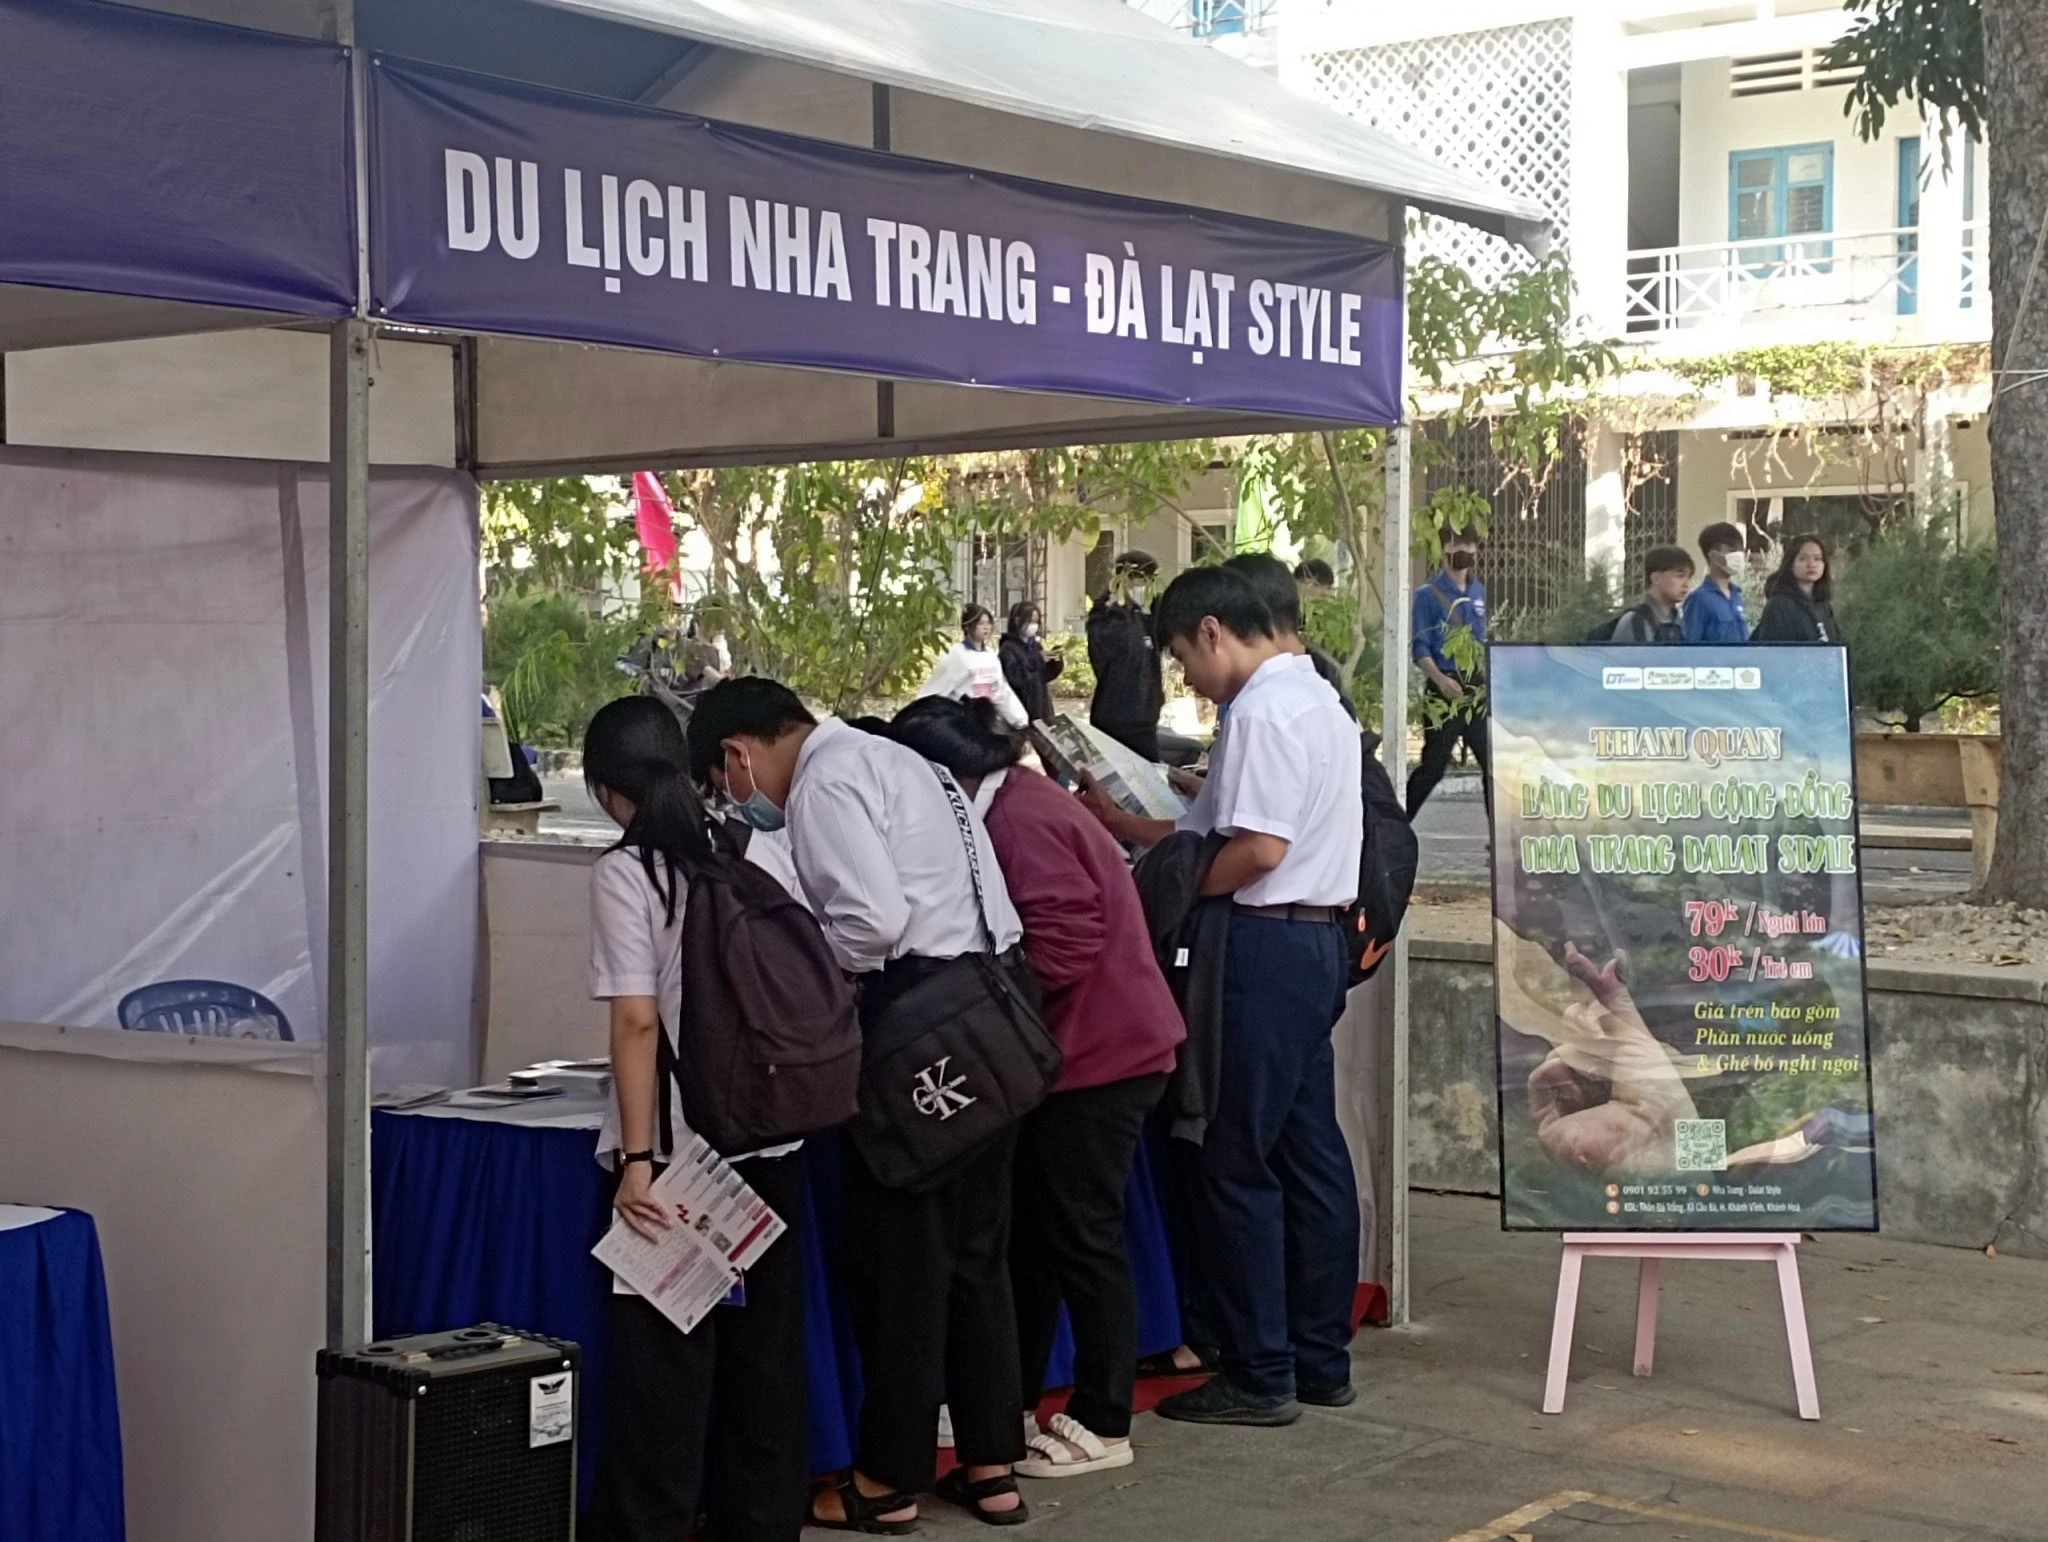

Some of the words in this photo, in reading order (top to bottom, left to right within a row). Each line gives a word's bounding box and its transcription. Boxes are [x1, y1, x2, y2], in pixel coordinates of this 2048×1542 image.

[445, 149, 540, 259] DU
[565, 168, 708, 293] LỊCH
[729, 195, 852, 301] NHA
[867, 218, 1036, 324] TRANG
[1053, 285, 1071, 304] -
[1084, 241, 1147, 340] ĐÀ
[1161, 265, 1235, 364] LẠT
[1248, 279, 1362, 366] STYLE
[1590, 727, 1688, 760] THAM
[1693, 727, 1782, 768] QUAN
[1521, 776, 1588, 819] LÀNG
[1596, 782, 1632, 819] DU
[1640, 782, 1700, 823] LỊCH
[1708, 776, 1777, 823] CỘNG
[1784, 771, 1853, 820] ĐỒNG
[1521, 835, 1579, 874] NHA
[1587, 835, 1676, 873] TRANG
[1683, 835, 1769, 874] DALAT
[1778, 835, 1856, 874] STYLE
[1694, 1001, 1725, 1020] Giá
[1730, 1003, 1764, 1020] trên
[1771, 1002, 1801, 1020] bao
[1695, 1028, 1741, 1046] Phần
[1791, 1029, 1834, 1049] uống
[1696, 1054, 1710, 1072] &
[1715, 1054, 1750, 1072] Ghế
